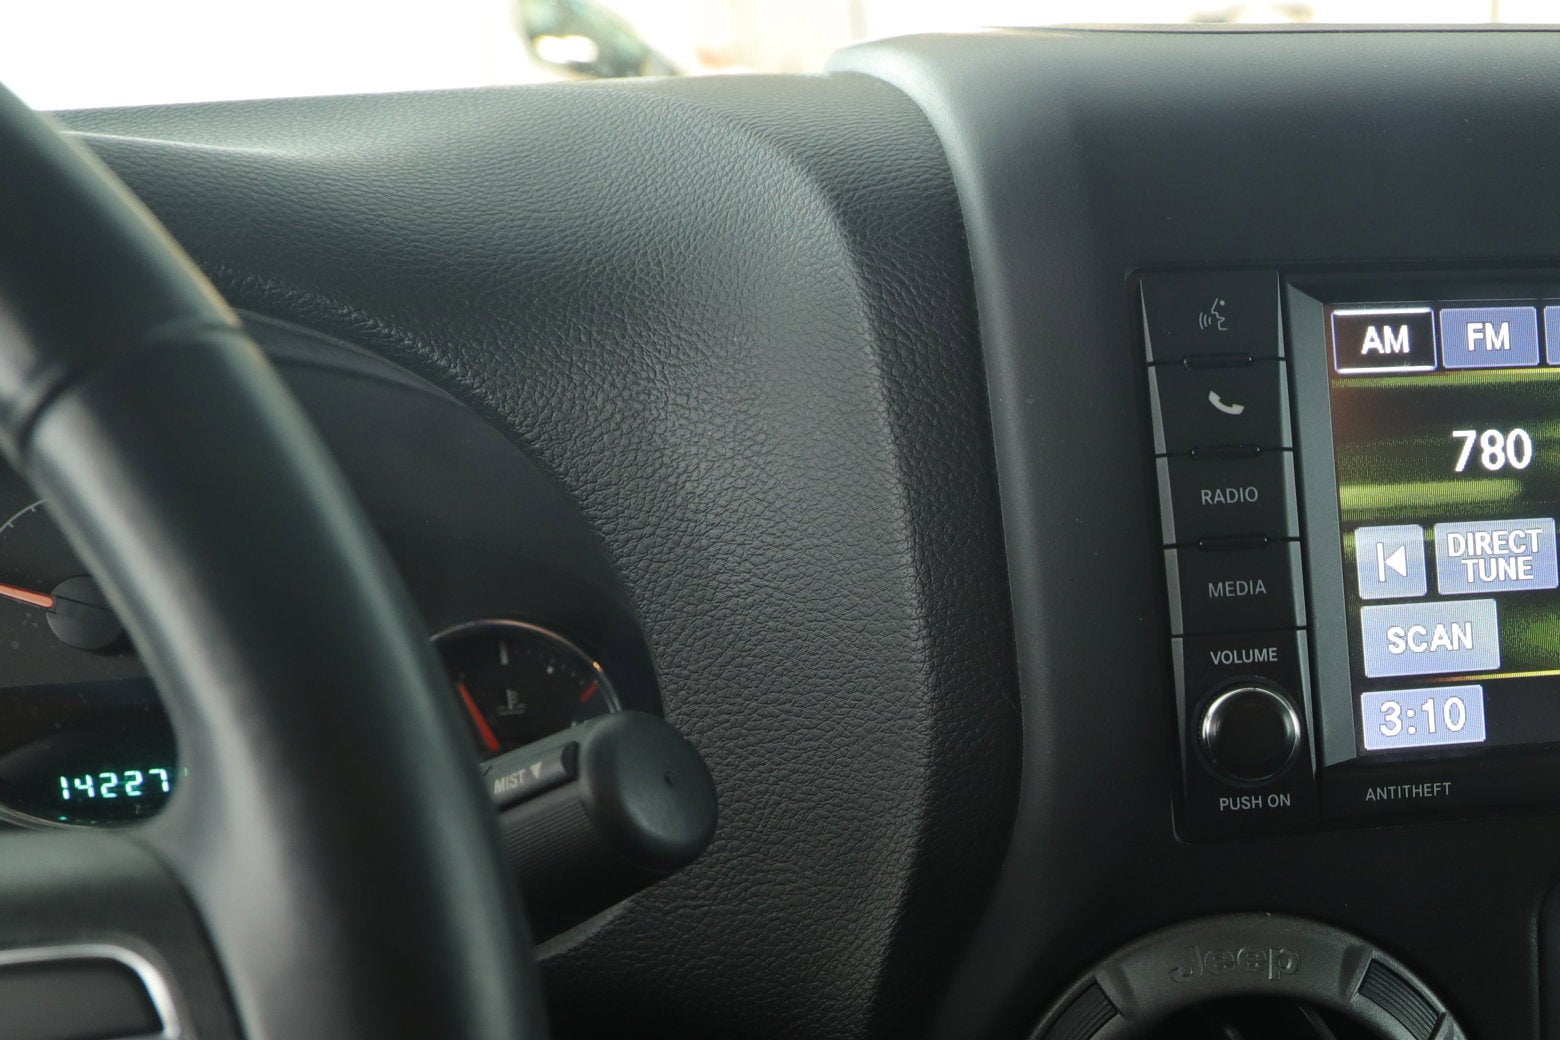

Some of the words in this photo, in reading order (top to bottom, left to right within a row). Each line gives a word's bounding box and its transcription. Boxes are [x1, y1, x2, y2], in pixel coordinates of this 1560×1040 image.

[1361, 325, 1410, 355] AM
[1466, 321, 1511, 352] FM
[1452, 428, 1533, 473] 780
[1200, 486, 1259, 506] RADIO
[1447, 528, 1543, 558] DIRECT
[1461, 555, 1534, 584] TUNE
[1208, 579, 1268, 599] MEDIA
[1386, 621, 1474, 655] SCAN
[1210, 647, 1279, 666] VOLUME
[1378, 696, 1468, 737] 3:10
[60, 768, 170, 800] 14227
[493, 768, 527, 795] MIST
[1365, 782, 1452, 802] ANTITHEFT
[1219, 796, 1262, 811] PUSH
[1267, 794, 1292, 808] ON
[1168, 946, 1301, 983] Jeep
